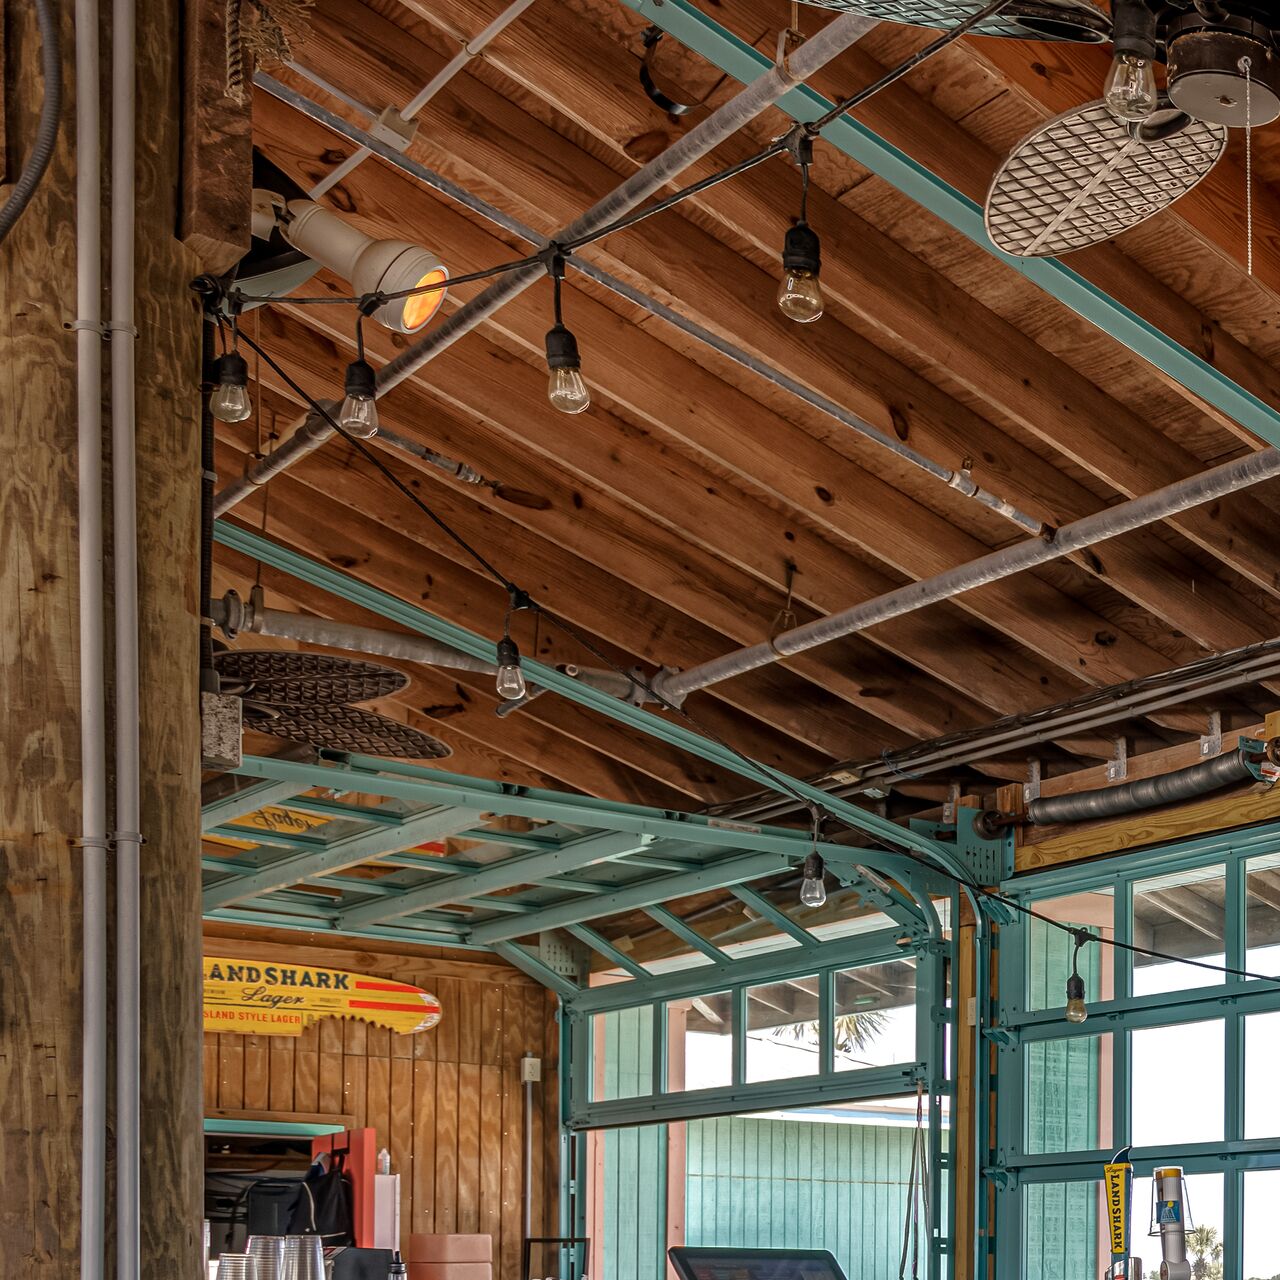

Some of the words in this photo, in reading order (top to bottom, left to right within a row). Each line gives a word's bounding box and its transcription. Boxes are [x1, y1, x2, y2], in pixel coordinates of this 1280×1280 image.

[204, 963, 351, 991] ANDSHARK
[241, 986, 305, 1009] Lager
[204, 1010, 236, 1021] SLAND
[238, 1011, 269, 1023] STYLE
[271, 1013, 301, 1025] LAGER
[1110, 1173, 1123, 1249] LANDSHARK
